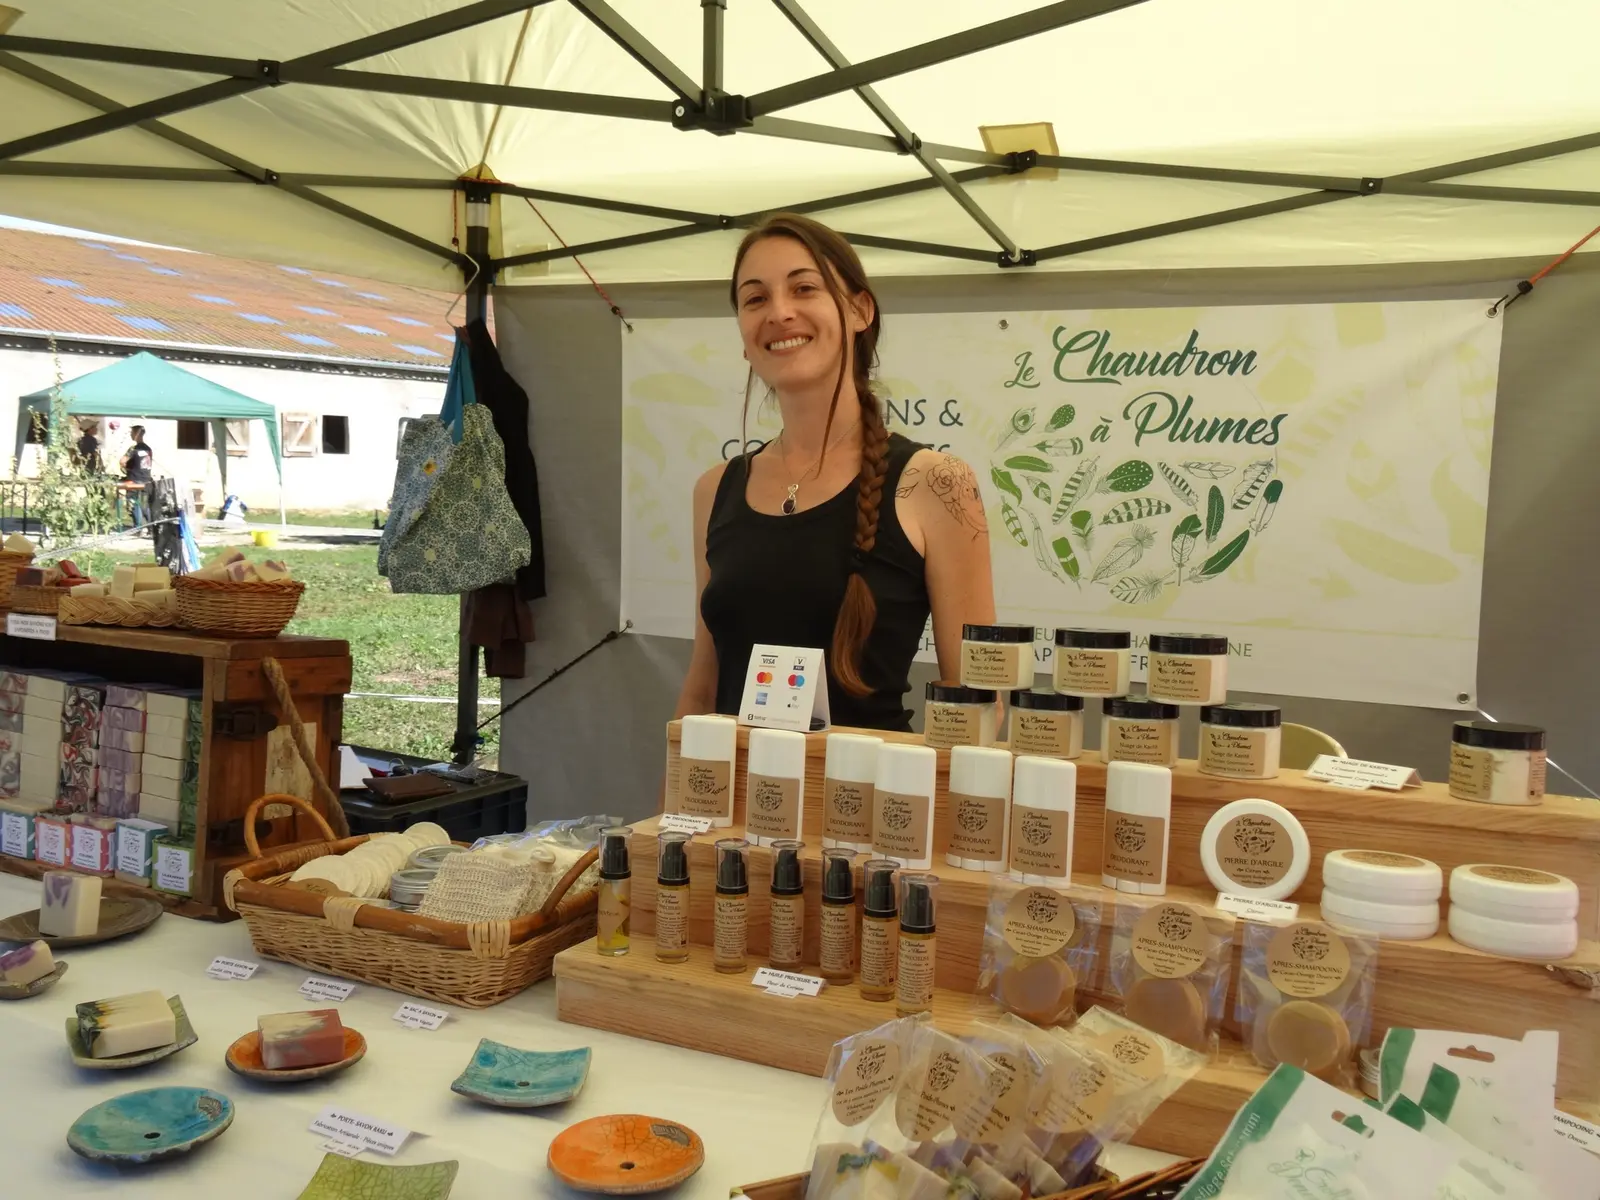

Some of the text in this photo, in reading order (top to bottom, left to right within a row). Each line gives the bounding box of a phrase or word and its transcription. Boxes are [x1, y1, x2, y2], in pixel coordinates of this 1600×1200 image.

[1004, 325, 1257, 388] Le Chaudron
[939, 399, 963, 427] &
[1090, 391, 1288, 447] à Plumes
[1224, 857, 1284, 868] PIERRE D'ARGILE
[1233, 897, 1283, 909] PIERRE D'ARGILE
[314, 1120, 338, 1133] Fabrication
[355, 1120, 373, 1131] SAVON
[1568, 1134, 1587, 1145] Douce
